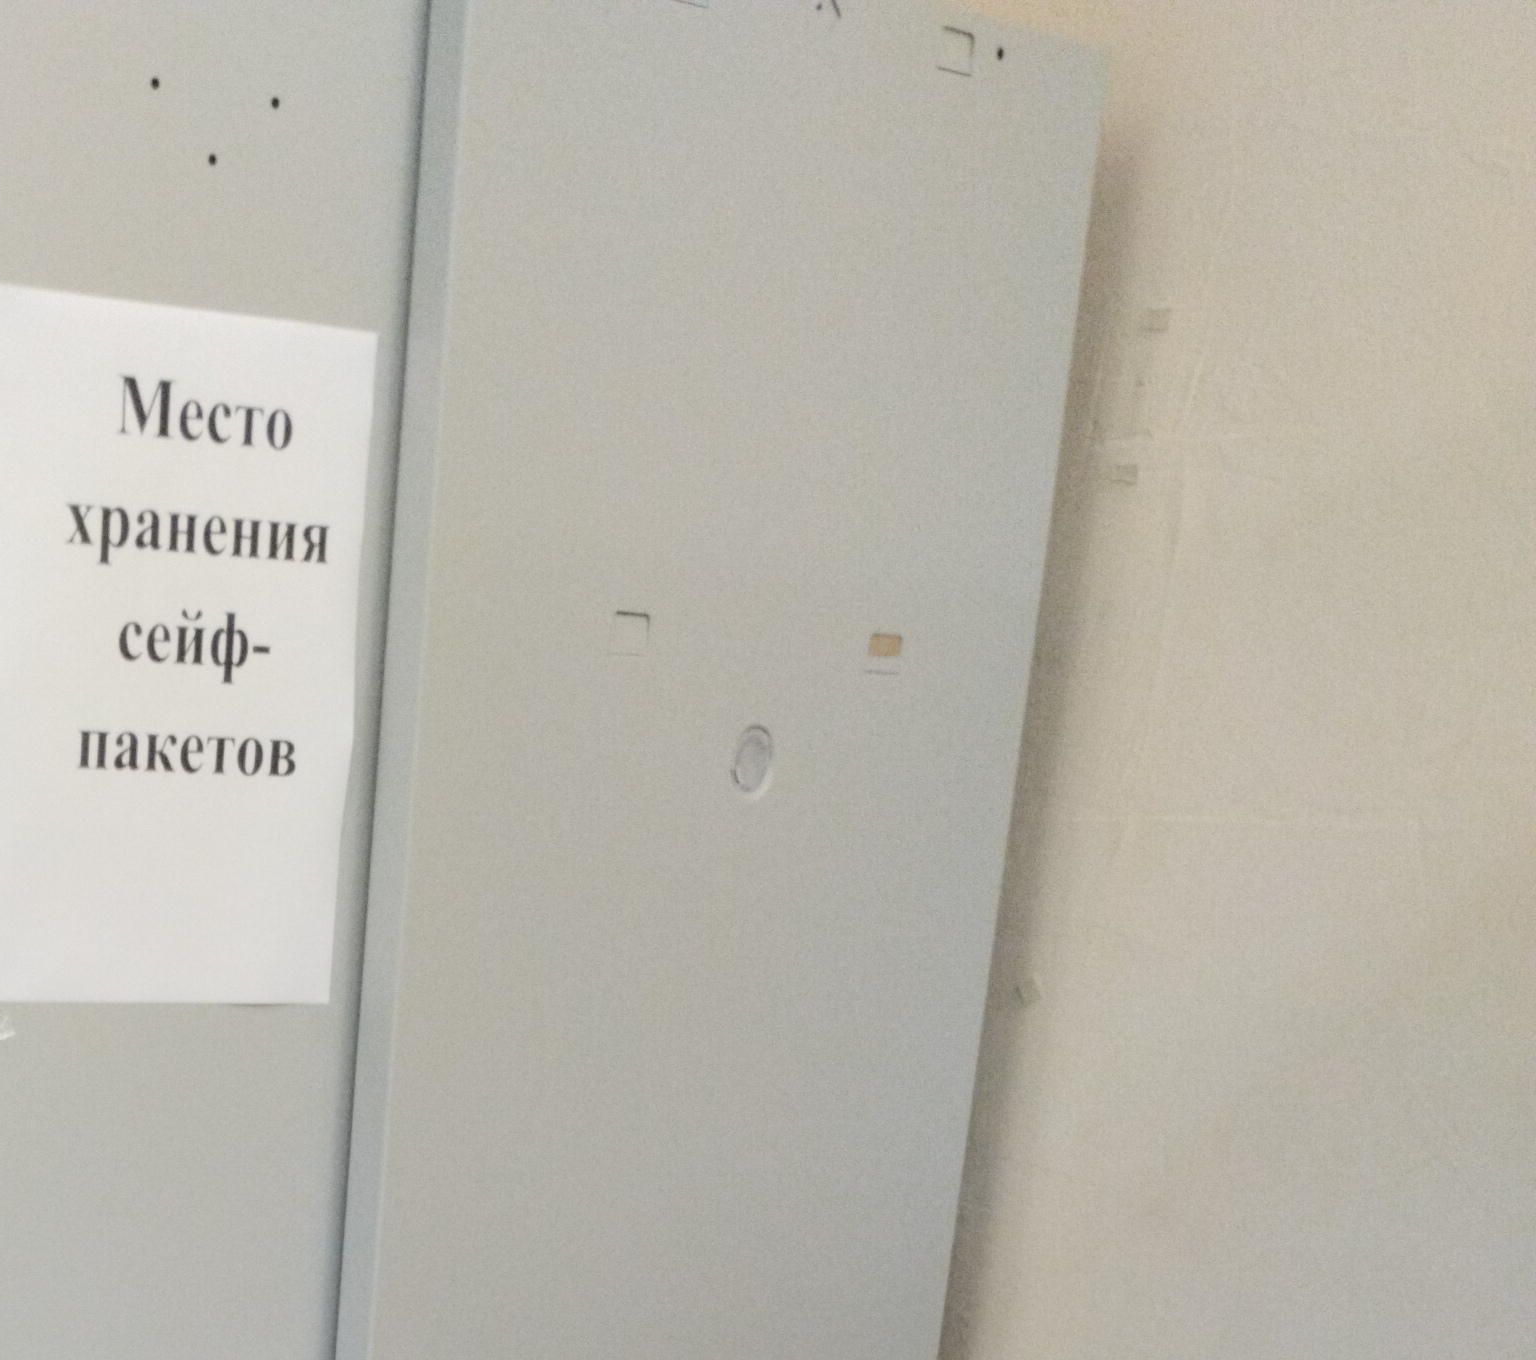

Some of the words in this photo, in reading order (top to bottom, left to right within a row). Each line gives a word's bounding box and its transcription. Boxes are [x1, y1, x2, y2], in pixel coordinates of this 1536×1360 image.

[119, 373, 294, 451] Место
[66, 502, 329, 564] хранения
[119, 610, 270, 683] сейф-
[77, 727, 297, 777] пакетов
